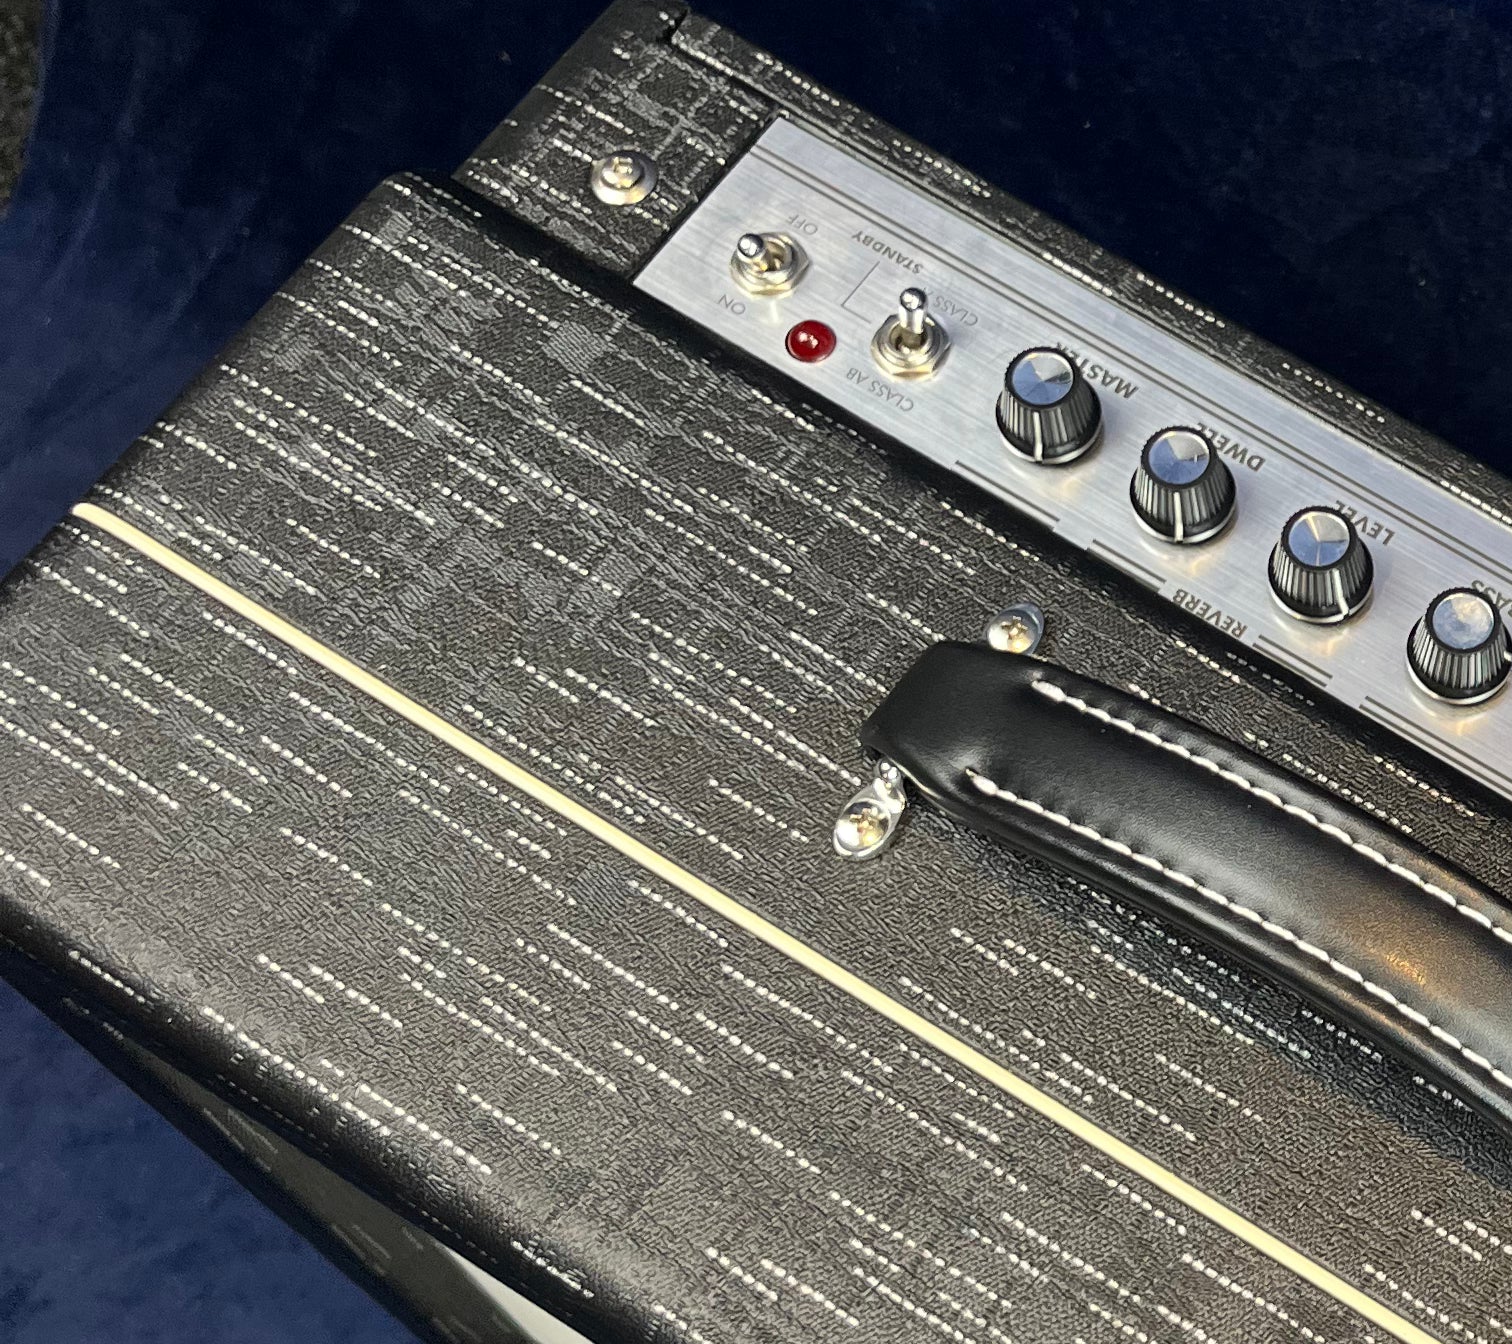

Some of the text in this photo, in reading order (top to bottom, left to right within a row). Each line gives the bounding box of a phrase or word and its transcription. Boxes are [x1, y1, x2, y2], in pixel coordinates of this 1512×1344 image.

[784, 210, 819, 235] OFF
[850, 230, 923, 273] STANDBY
[716, 294, 747, 315] ON
[933, 296, 979, 326] CLASS
[844, 367, 915, 411] CLASS AB
[1169, 587, 1249, 637] REVERB
